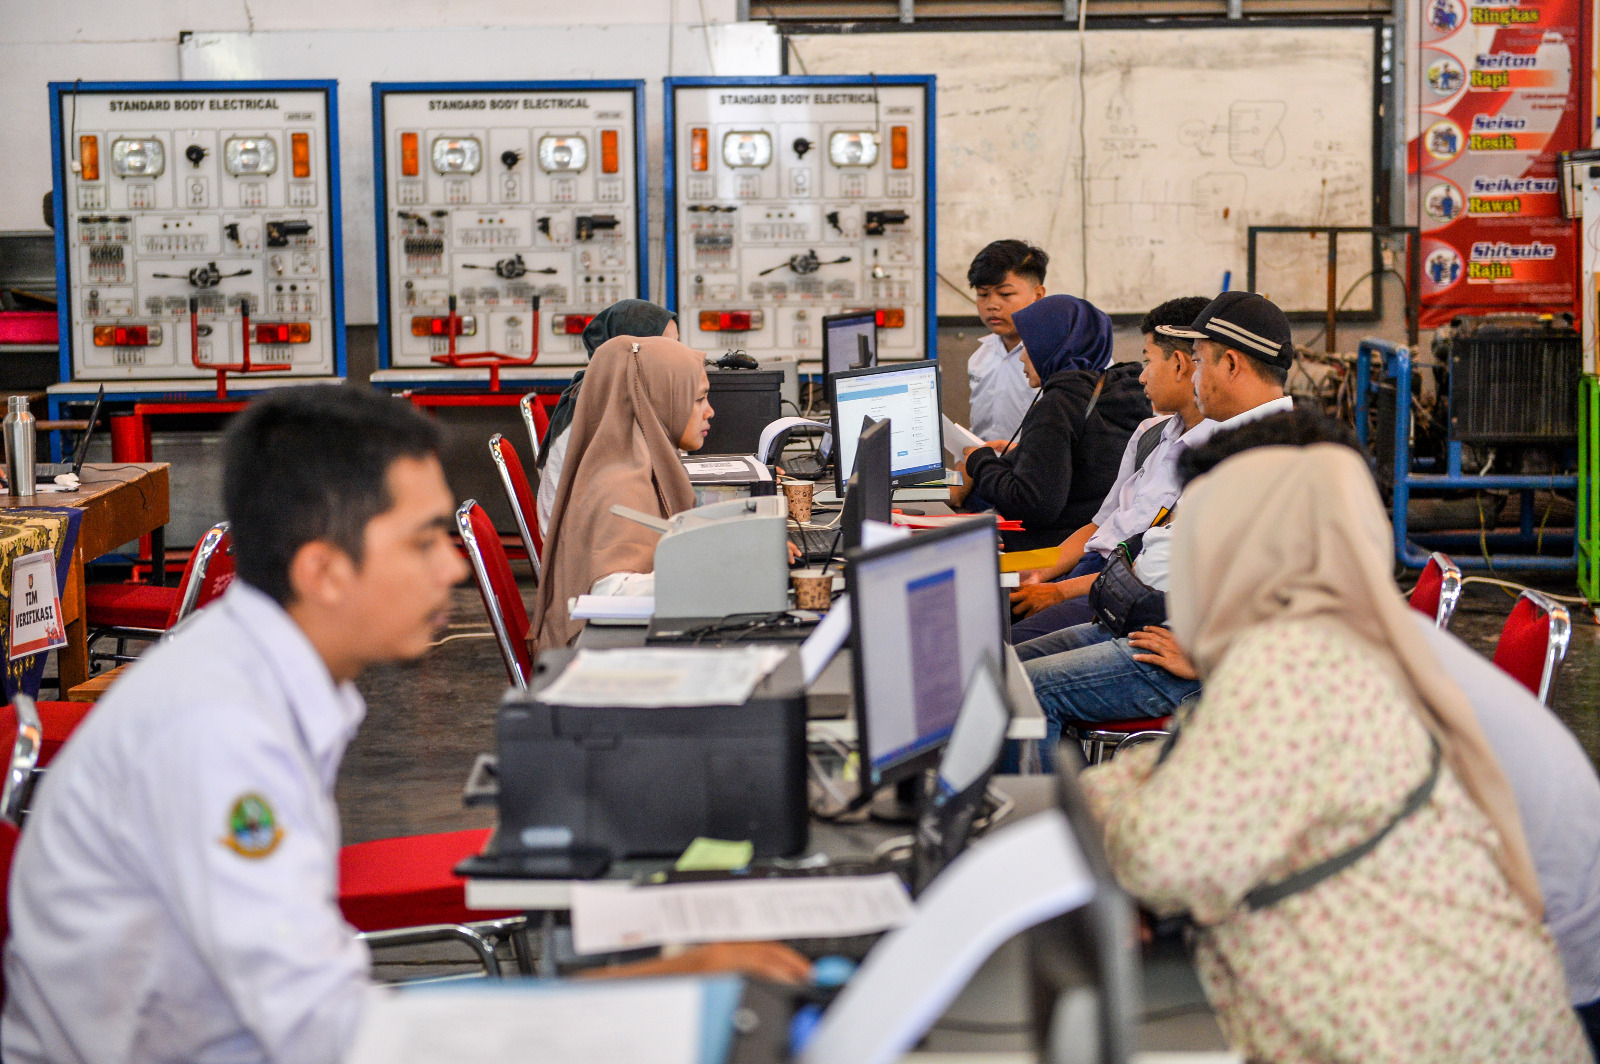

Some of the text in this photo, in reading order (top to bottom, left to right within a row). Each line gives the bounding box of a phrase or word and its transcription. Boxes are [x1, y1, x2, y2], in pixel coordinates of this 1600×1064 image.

[1471, 6, 1540, 28] Ringkas
[1475, 54, 1537, 67] Seiton
[1470, 70, 1509, 90] Rapi
[109, 98, 279, 111] STANDARD BODY ELECTRICAL
[428, 98, 590, 111] STANDARD BODY ELECTRICAL
[720, 93, 879, 105] STANDARD BODY ELECTRICAL
[1475, 117, 1526, 129] Seiso
[1470, 135, 1517, 150] Resik
[1474, 179, 1558, 192] Seiketsu
[1469, 197, 1521, 213] Rawat
[1473, 244, 1554, 257] Shitsuke
[1468, 262, 1513, 281] Rajin
[25, 590, 38, 606] TIM
[15, 605, 54, 628] VERIFIKASI
